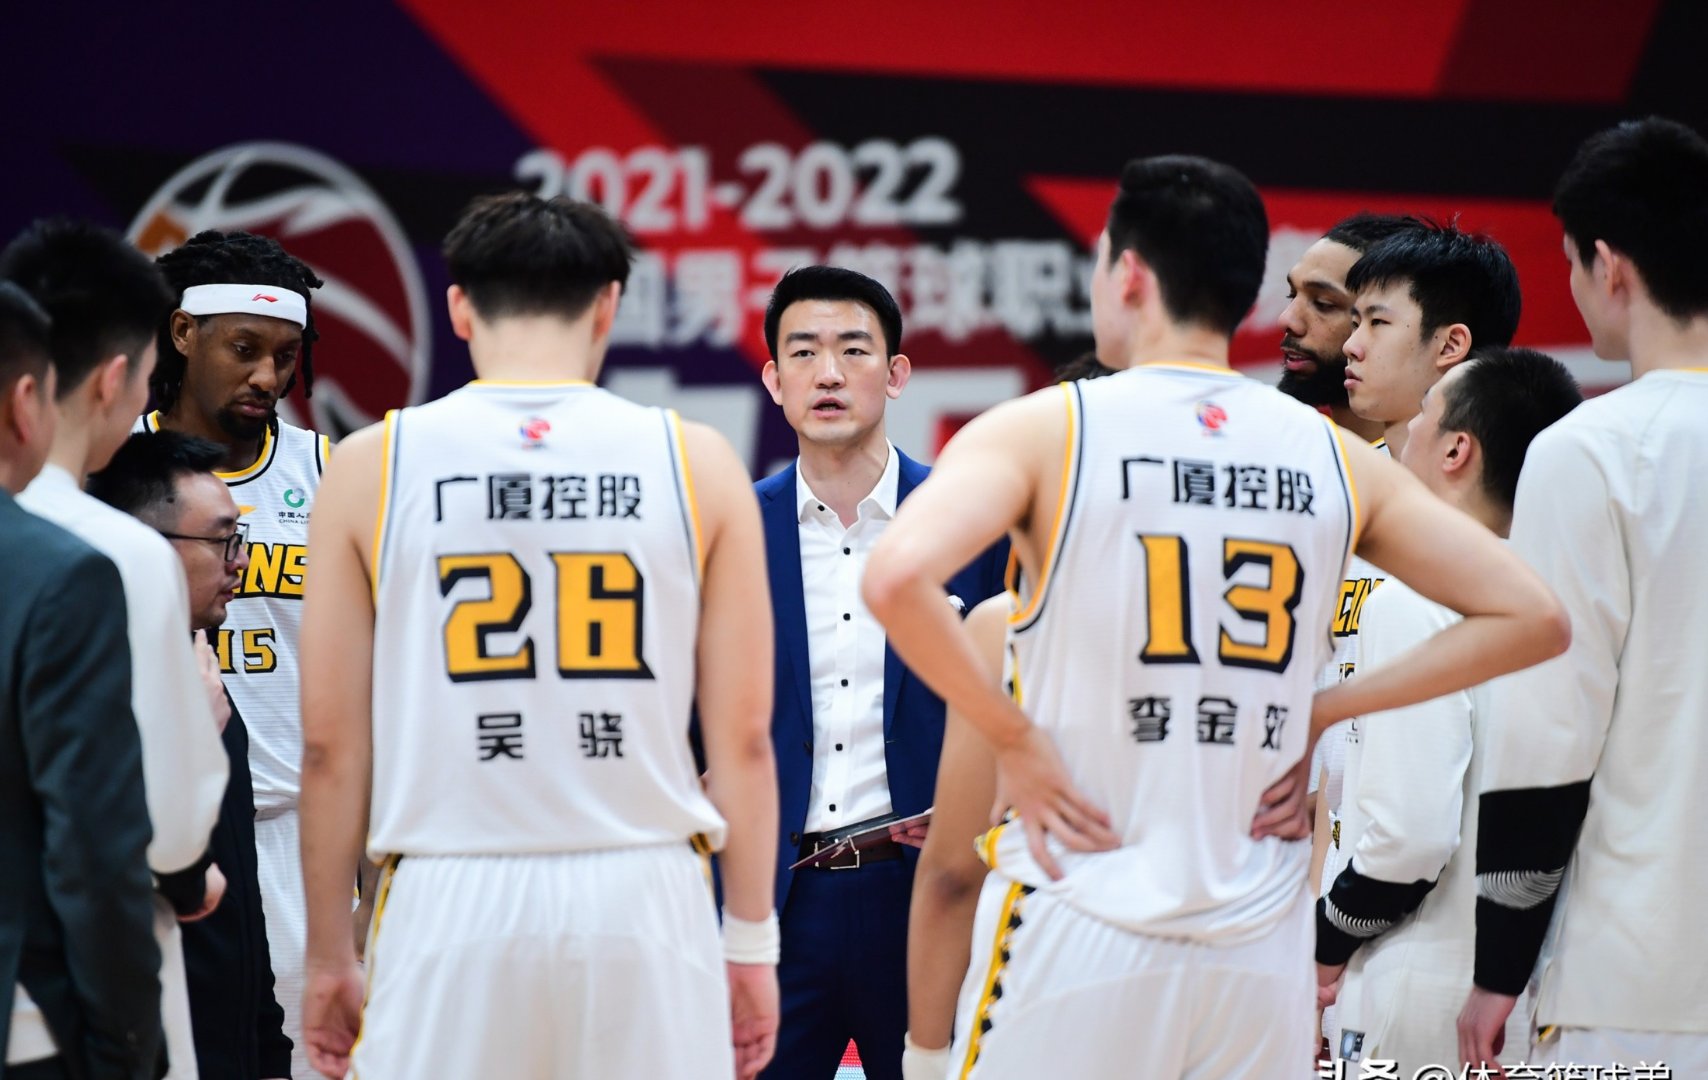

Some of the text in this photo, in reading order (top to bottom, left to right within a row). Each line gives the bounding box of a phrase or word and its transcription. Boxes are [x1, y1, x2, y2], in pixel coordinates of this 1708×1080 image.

[514, 136, 963, 231] 2021-2022
[434, 474, 643, 523] 广厦控股
[1120, 456, 1316, 517] 广厦控股
[436, 551, 656, 683] 26
[1136, 533, 1306, 675] 13
